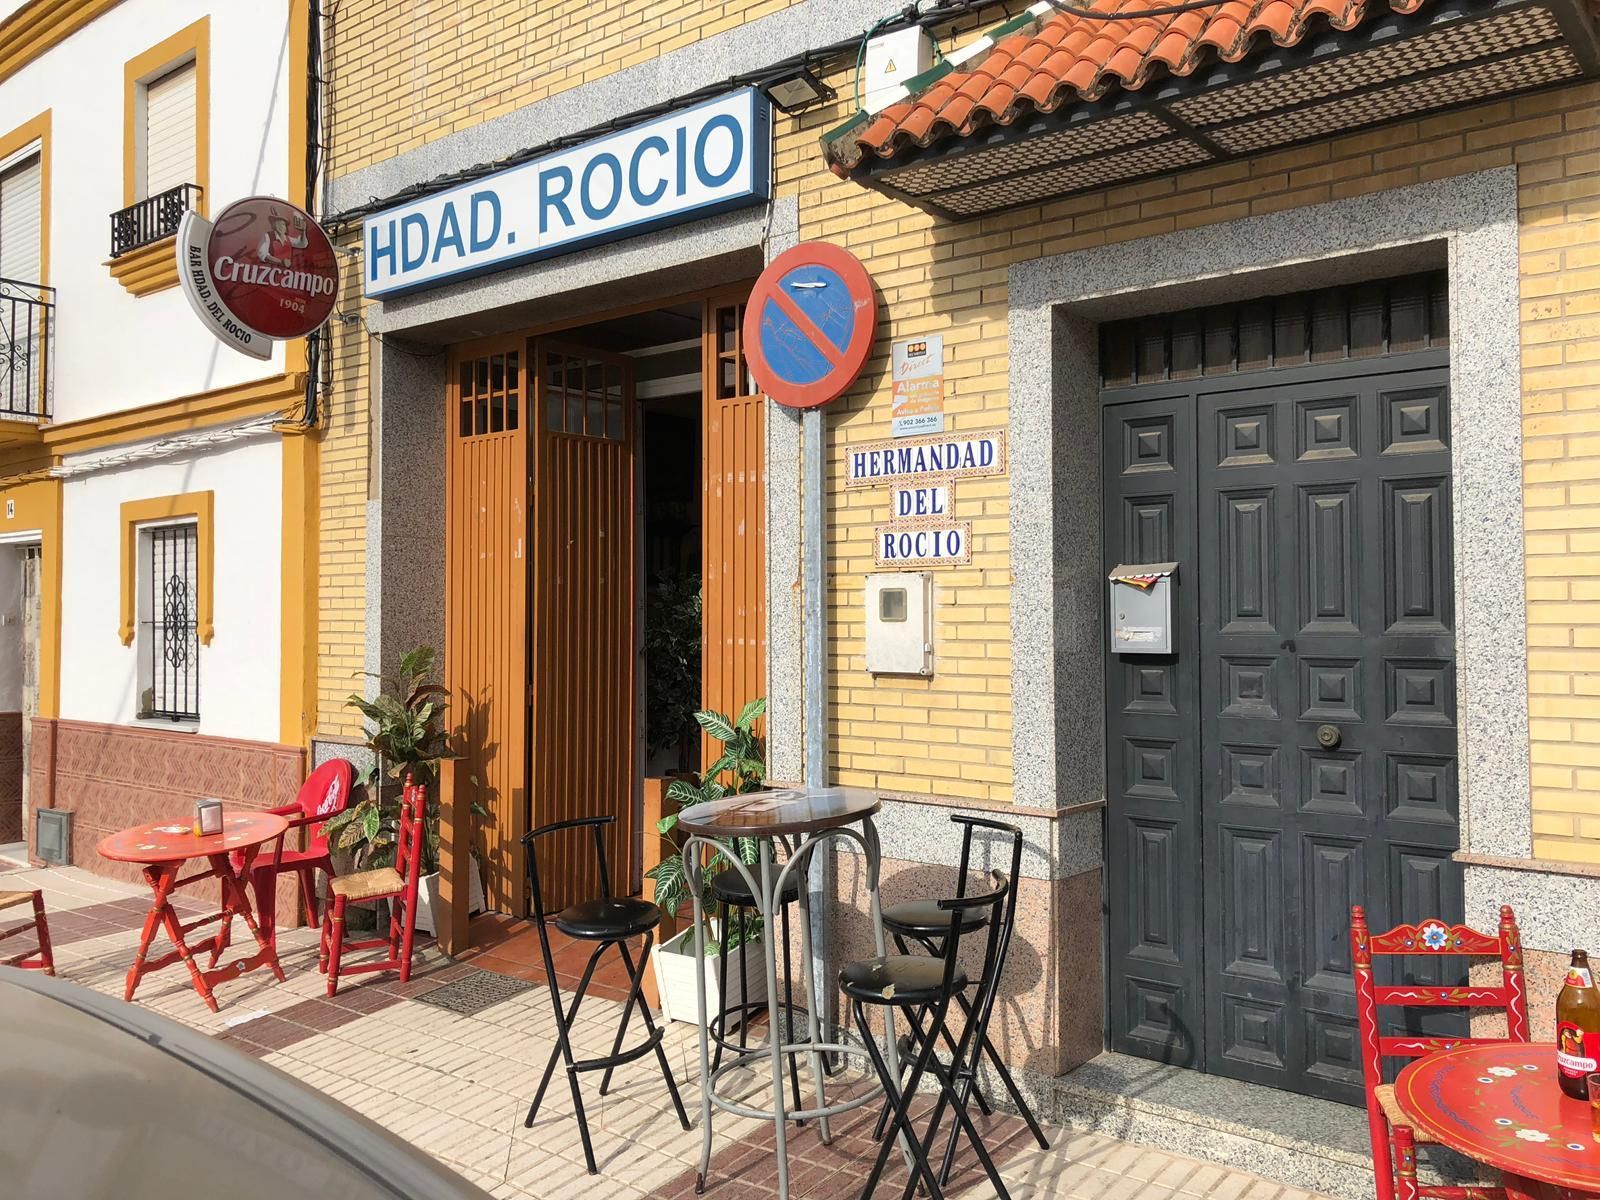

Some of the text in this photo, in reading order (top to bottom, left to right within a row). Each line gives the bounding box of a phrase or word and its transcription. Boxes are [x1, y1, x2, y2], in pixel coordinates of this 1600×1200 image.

[370, 113, 744, 282] HDAD. ROCIO
[213, 255, 334, 297] Cruzcampo
[189, 245, 252, 344] BAR HDAD. DEL ROCIO
[279, 298, 305, 314] 1904
[903, 415, 938, 426] 902 366 366
[853, 439, 993, 478] HERMANDAD
[899, 488, 943, 516] DEL
[883, 530, 961, 559] ROCIO
[1557, 1054, 1594, 1069] ruzcampo
